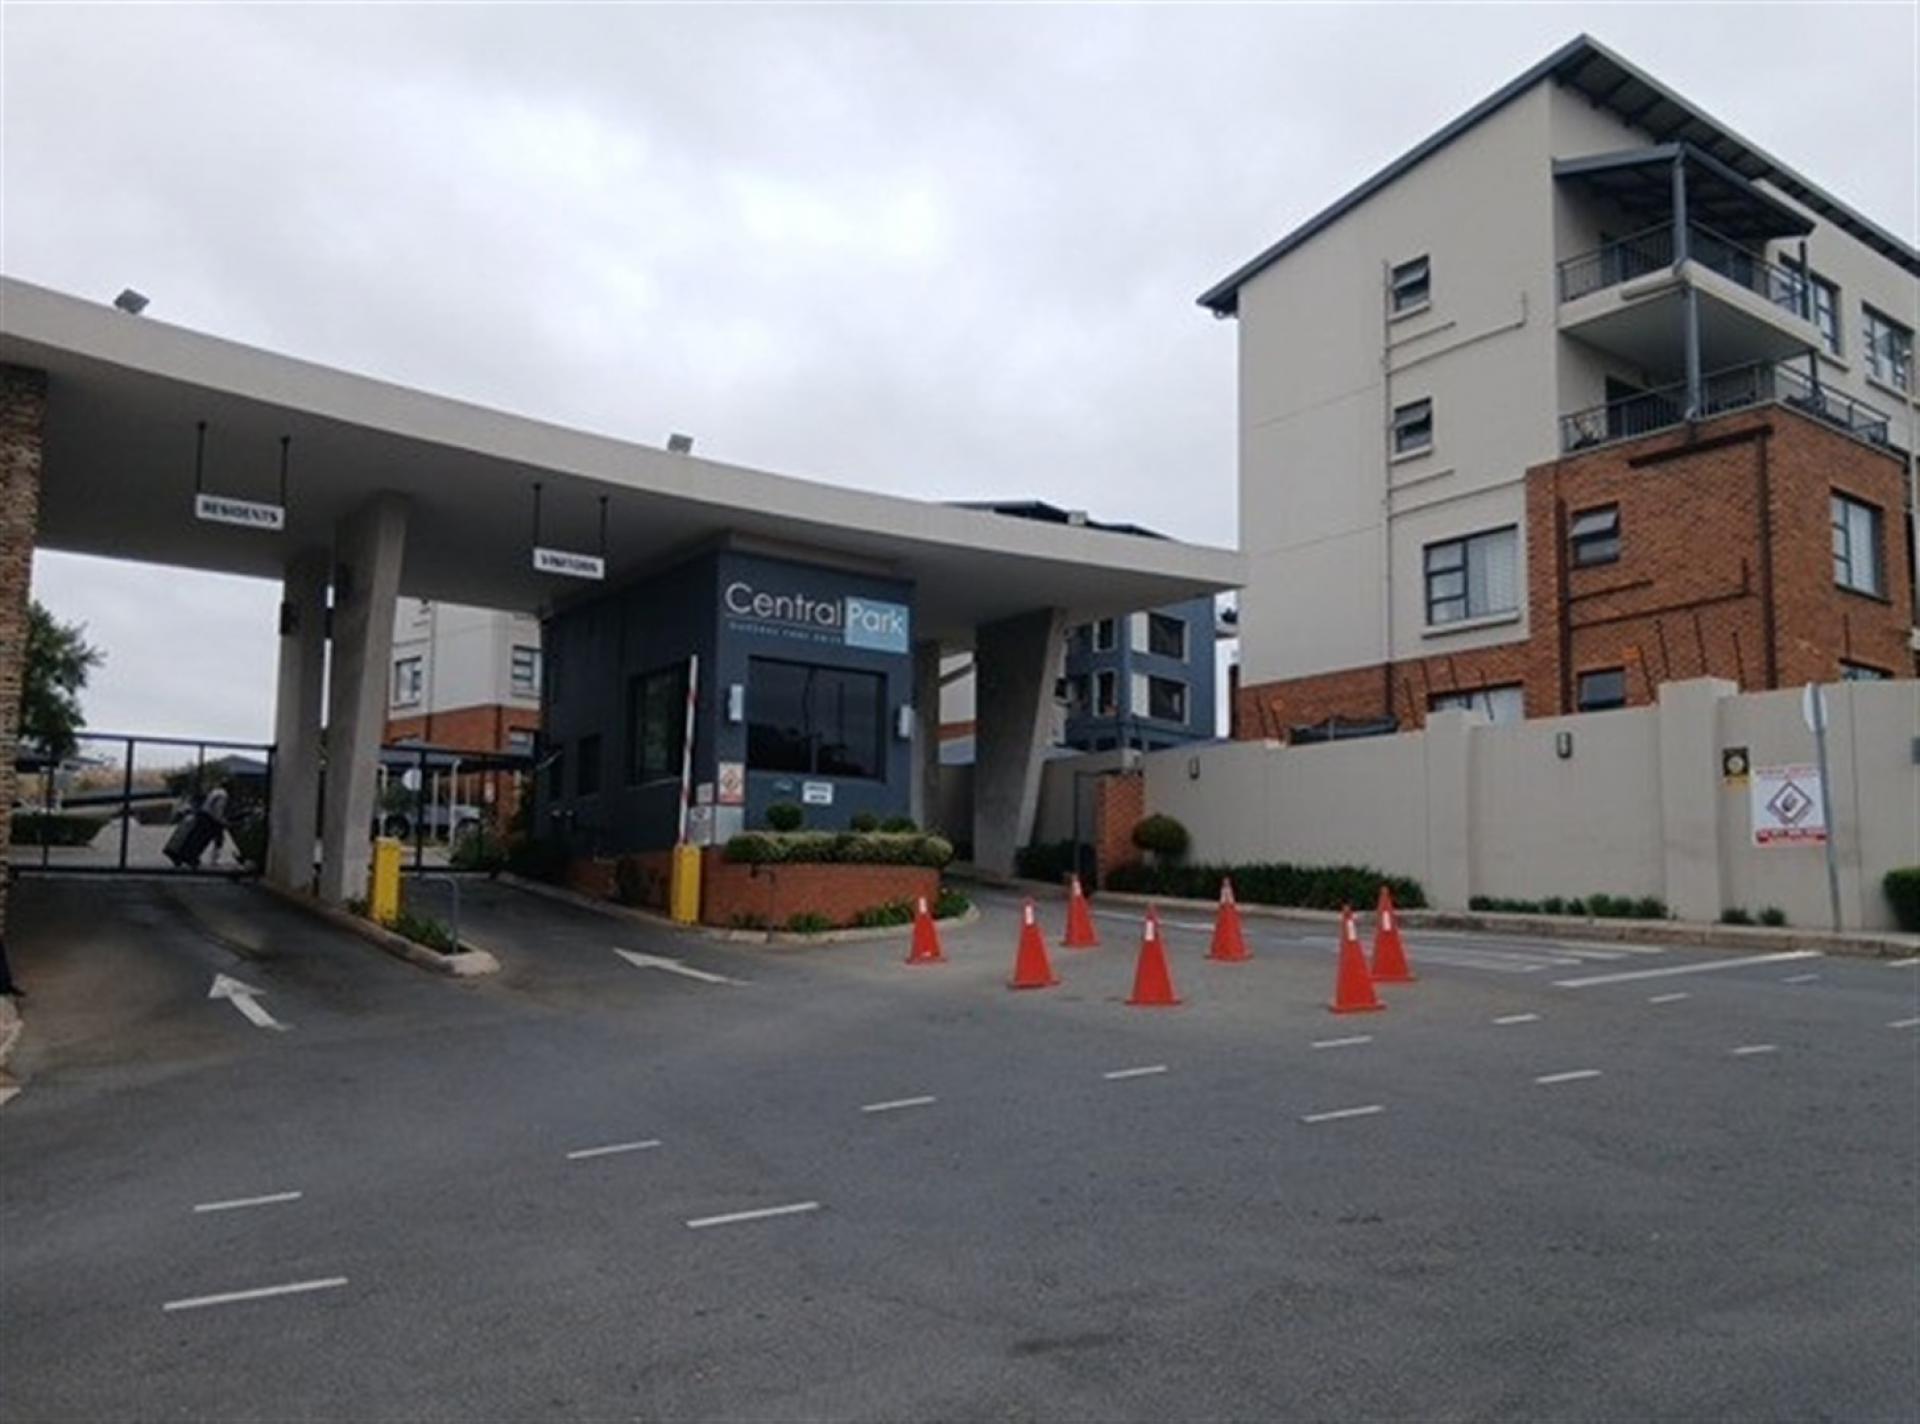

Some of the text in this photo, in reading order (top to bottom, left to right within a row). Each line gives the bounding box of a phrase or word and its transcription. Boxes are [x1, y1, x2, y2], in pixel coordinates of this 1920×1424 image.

[202, 500, 279, 523] RESIDENTS
[725, 582, 841, 626] Central
[848, 602, 903, 635] Park
